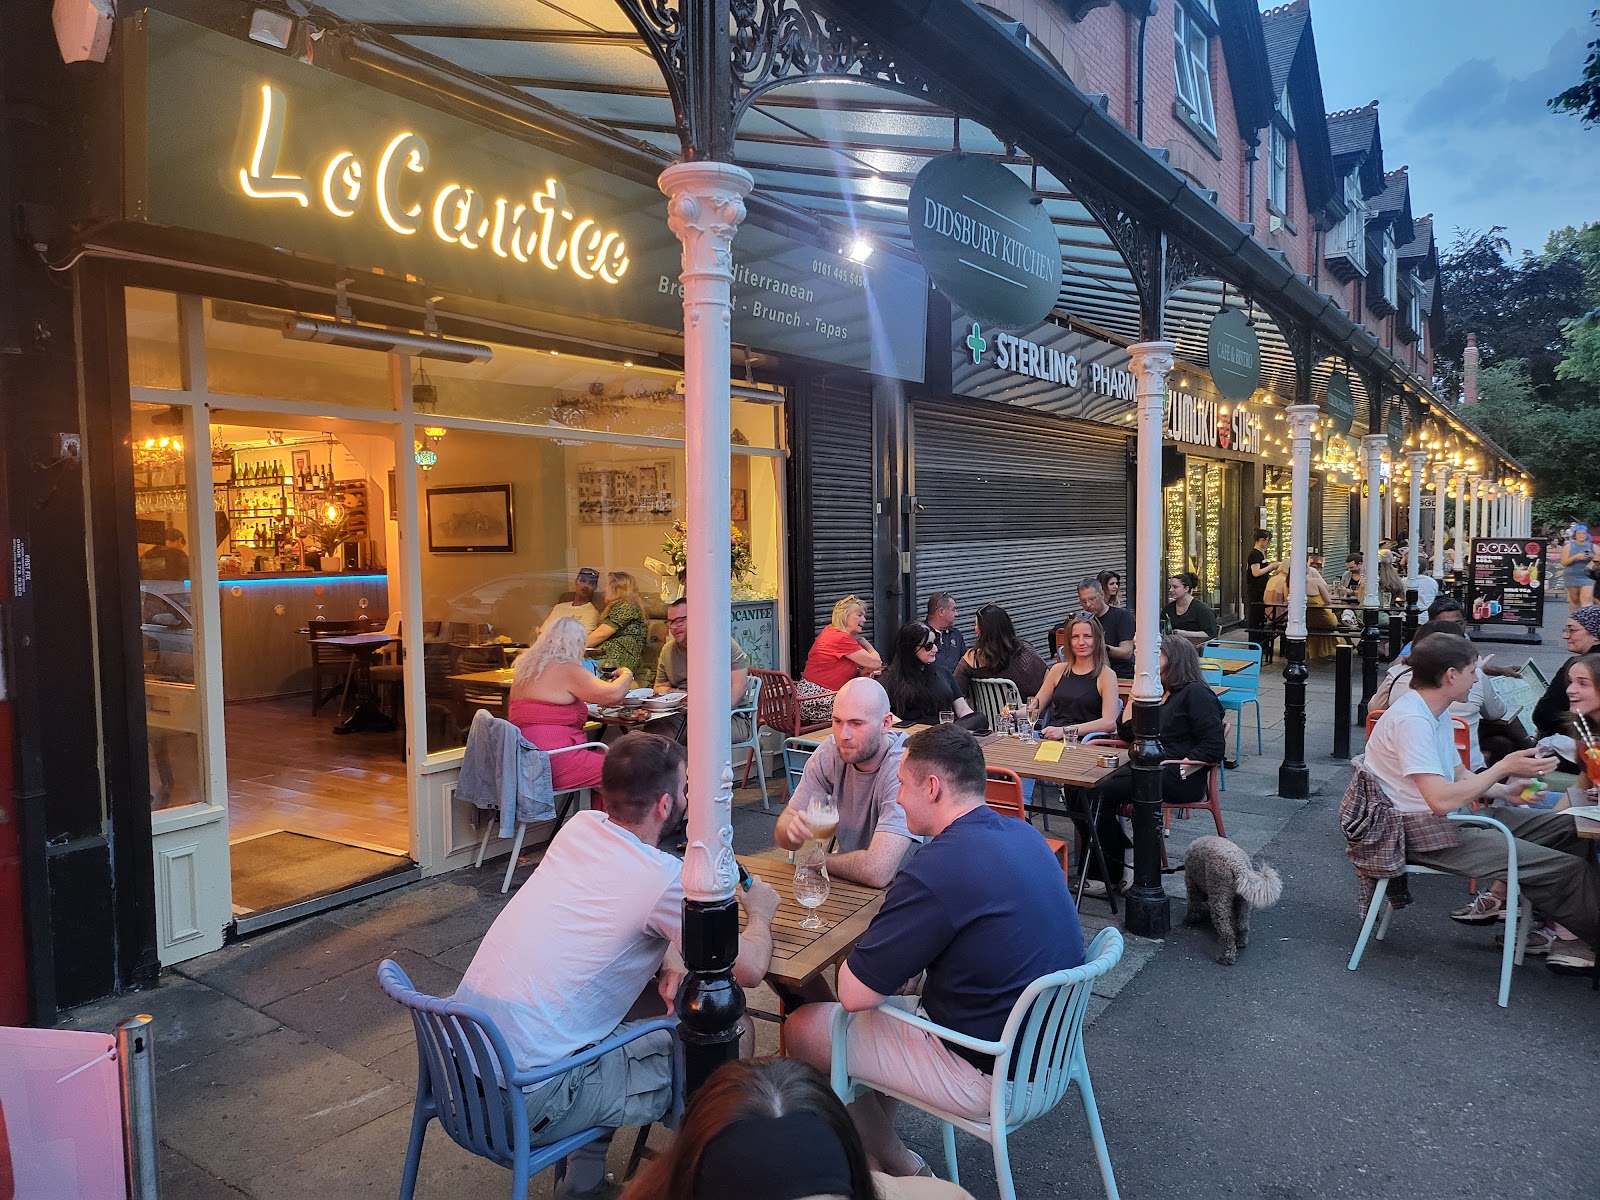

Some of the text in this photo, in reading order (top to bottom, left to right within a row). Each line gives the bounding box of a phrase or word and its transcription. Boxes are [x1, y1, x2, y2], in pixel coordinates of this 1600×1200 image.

[239, 83, 631, 285] LoCantee
[924, 197, 1055, 283] DIDSBURY KITCHEN
[730, 262, 814, 303] diterranean
[812, 260, 831, 276] 0161
[834, 267, 847, 282] 445
[753, 300, 801, 328] Brunch
[815, 317, 848, 339] Tapas
[996, 333, 1138, 402] STERLING PHARM
[1231, 408, 1260, 454] SUSHI
[1476, 543, 1522, 554] BOBA
